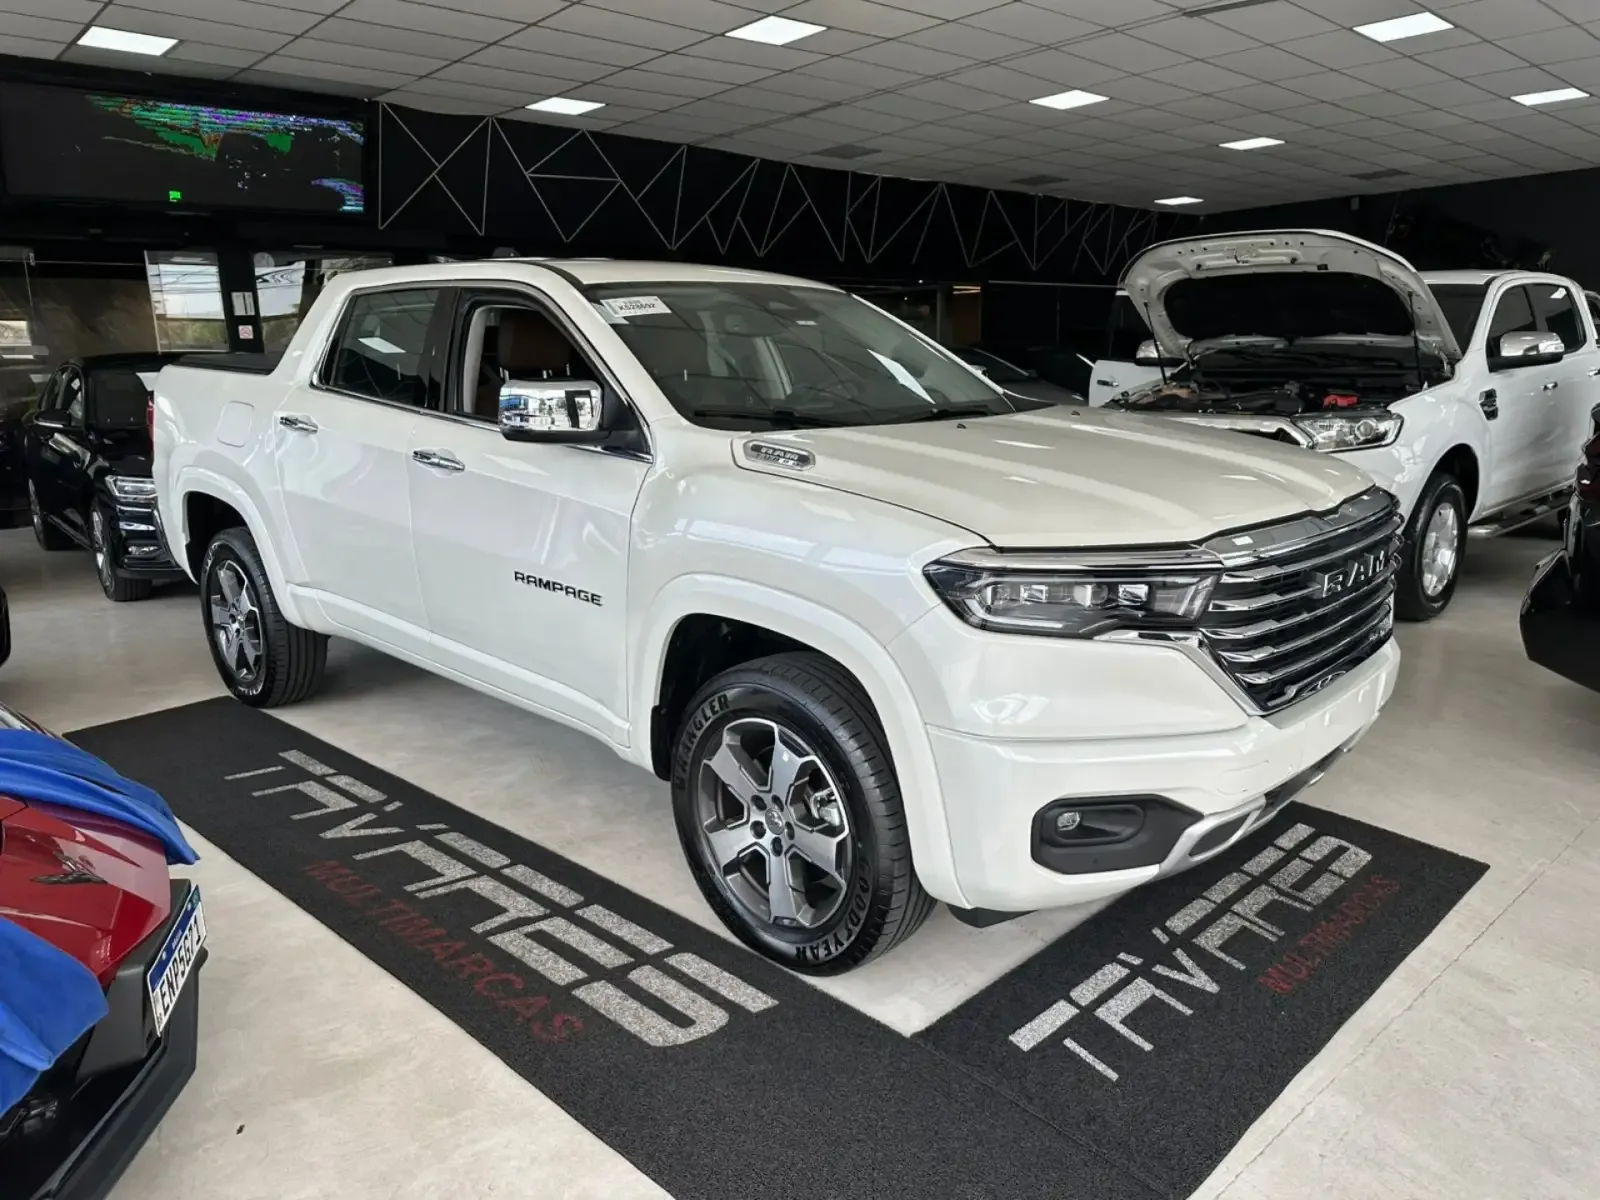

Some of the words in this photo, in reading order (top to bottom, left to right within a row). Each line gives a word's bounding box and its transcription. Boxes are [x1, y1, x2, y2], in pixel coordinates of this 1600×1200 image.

[513, 570, 604, 607] RAMPAGE
[1319, 550, 1386, 598] RAM
[224, 749, 779, 1047] TAVARES
[795, 857, 871, 961] GOODYEAR
[159, 915, 202, 1017] ENP5G71
[304, 860, 585, 1042] MULTIMARCAS
[1008, 822, 1373, 1081] TAVARES
